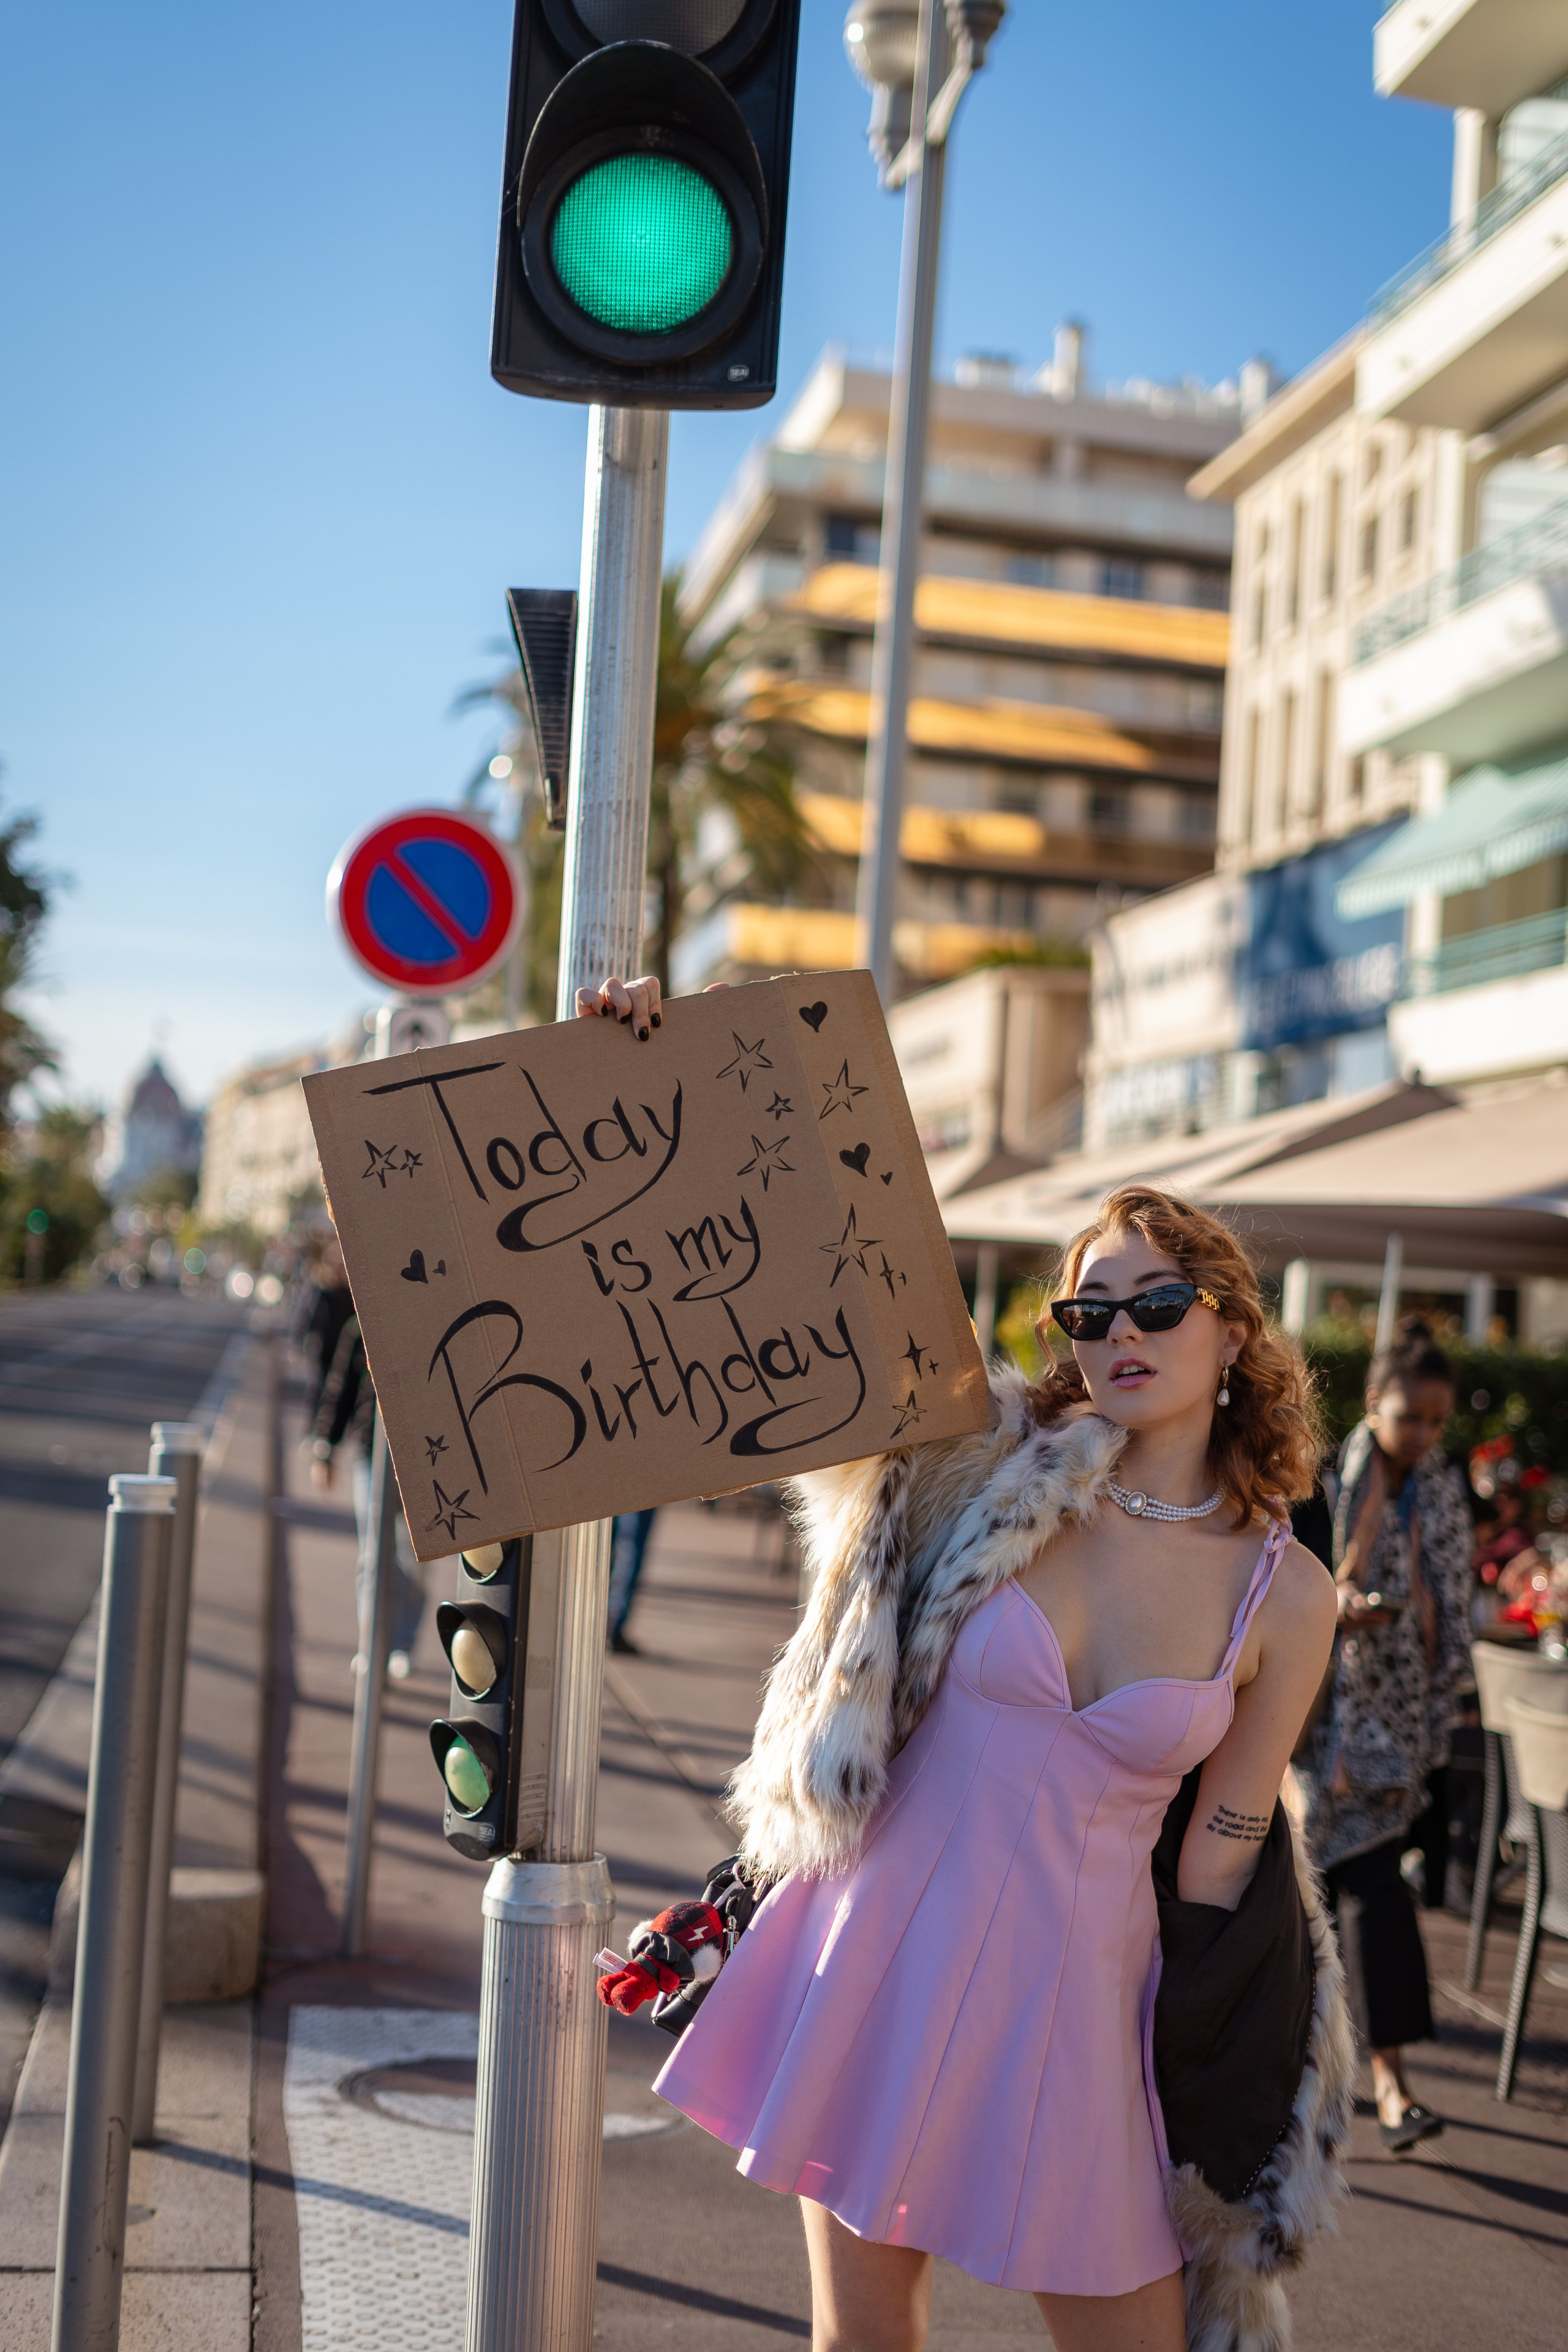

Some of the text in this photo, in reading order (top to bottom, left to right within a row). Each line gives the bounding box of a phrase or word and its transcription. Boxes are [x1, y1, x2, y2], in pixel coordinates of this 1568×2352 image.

[363, 1063, 683, 1252] Today
[581, 1195, 761, 1302] is my
[428, 1297, 866, 1496] Birthday
[1207, 1823, 1216, 1832] sky
[1218, 1829, 1242, 1839] above
[1213, 1815, 1224, 1825] the
[1225, 1822, 1244, 1830] road
[1218, 1805, 1237, 1819] There
